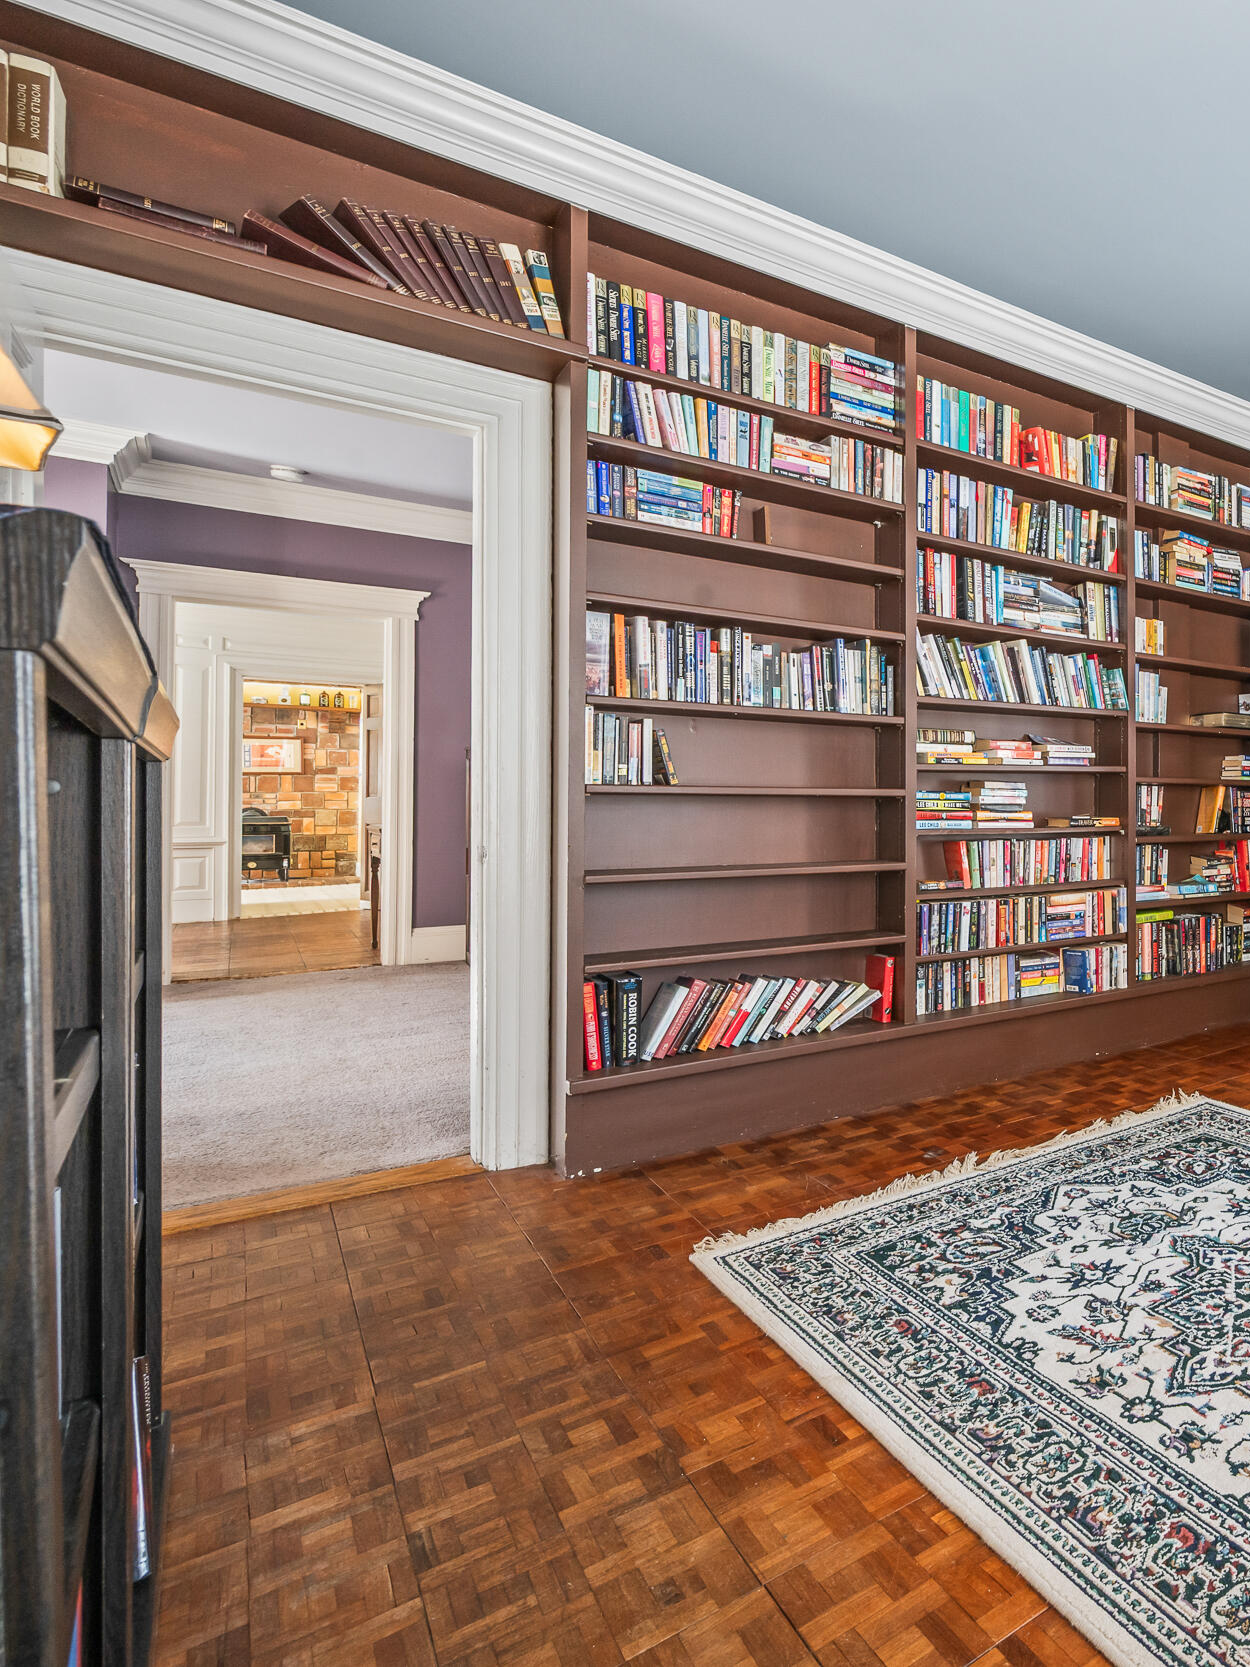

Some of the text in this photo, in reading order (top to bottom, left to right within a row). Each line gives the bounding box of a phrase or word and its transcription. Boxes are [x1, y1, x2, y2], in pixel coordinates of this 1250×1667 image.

[16, 83, 27, 133] DICTIONARY
[30, 83, 41, 141] WORLD BOOK
[722, 320, 730, 342] DANIELLE
[722, 342, 730, 356] STEEL
[628, 992, 638, 1058] ROBIN COOK
